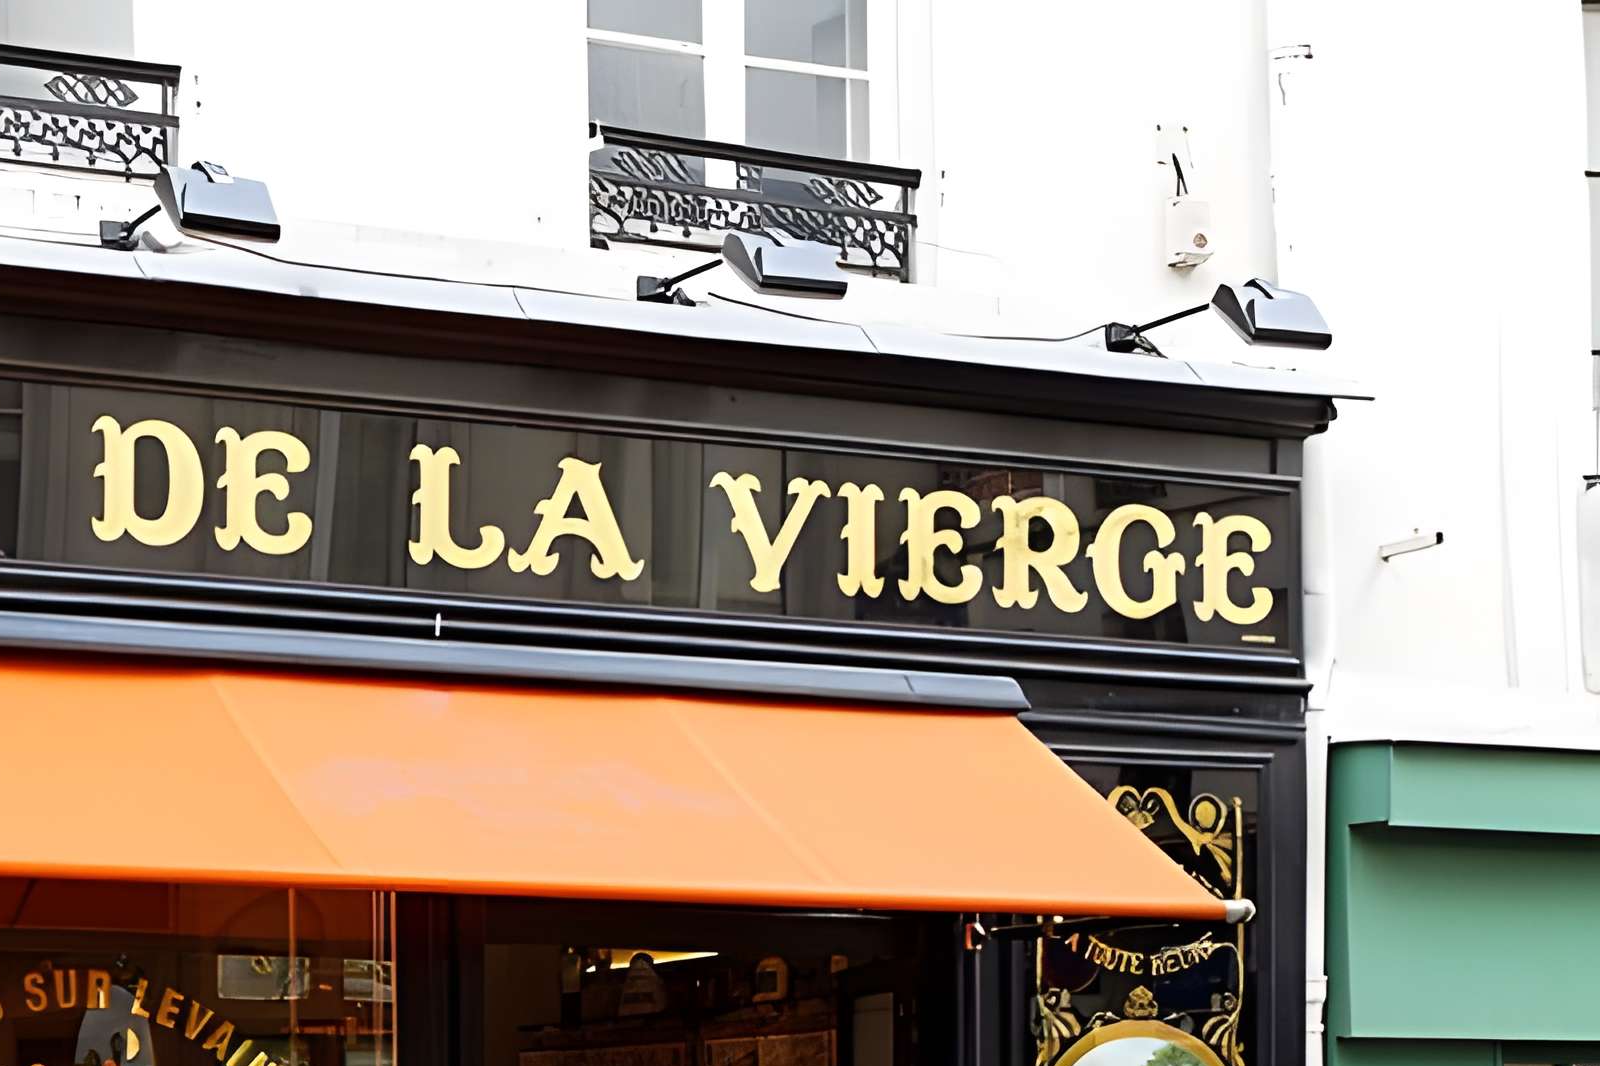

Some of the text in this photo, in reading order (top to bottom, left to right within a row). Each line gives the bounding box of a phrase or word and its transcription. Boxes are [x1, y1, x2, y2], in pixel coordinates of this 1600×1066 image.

[91, 415, 313, 555] DE
[408, 444, 643, 581] LA
[711, 472, 1274, 625] VIERGE
[24, 968, 111, 1012] SUR
